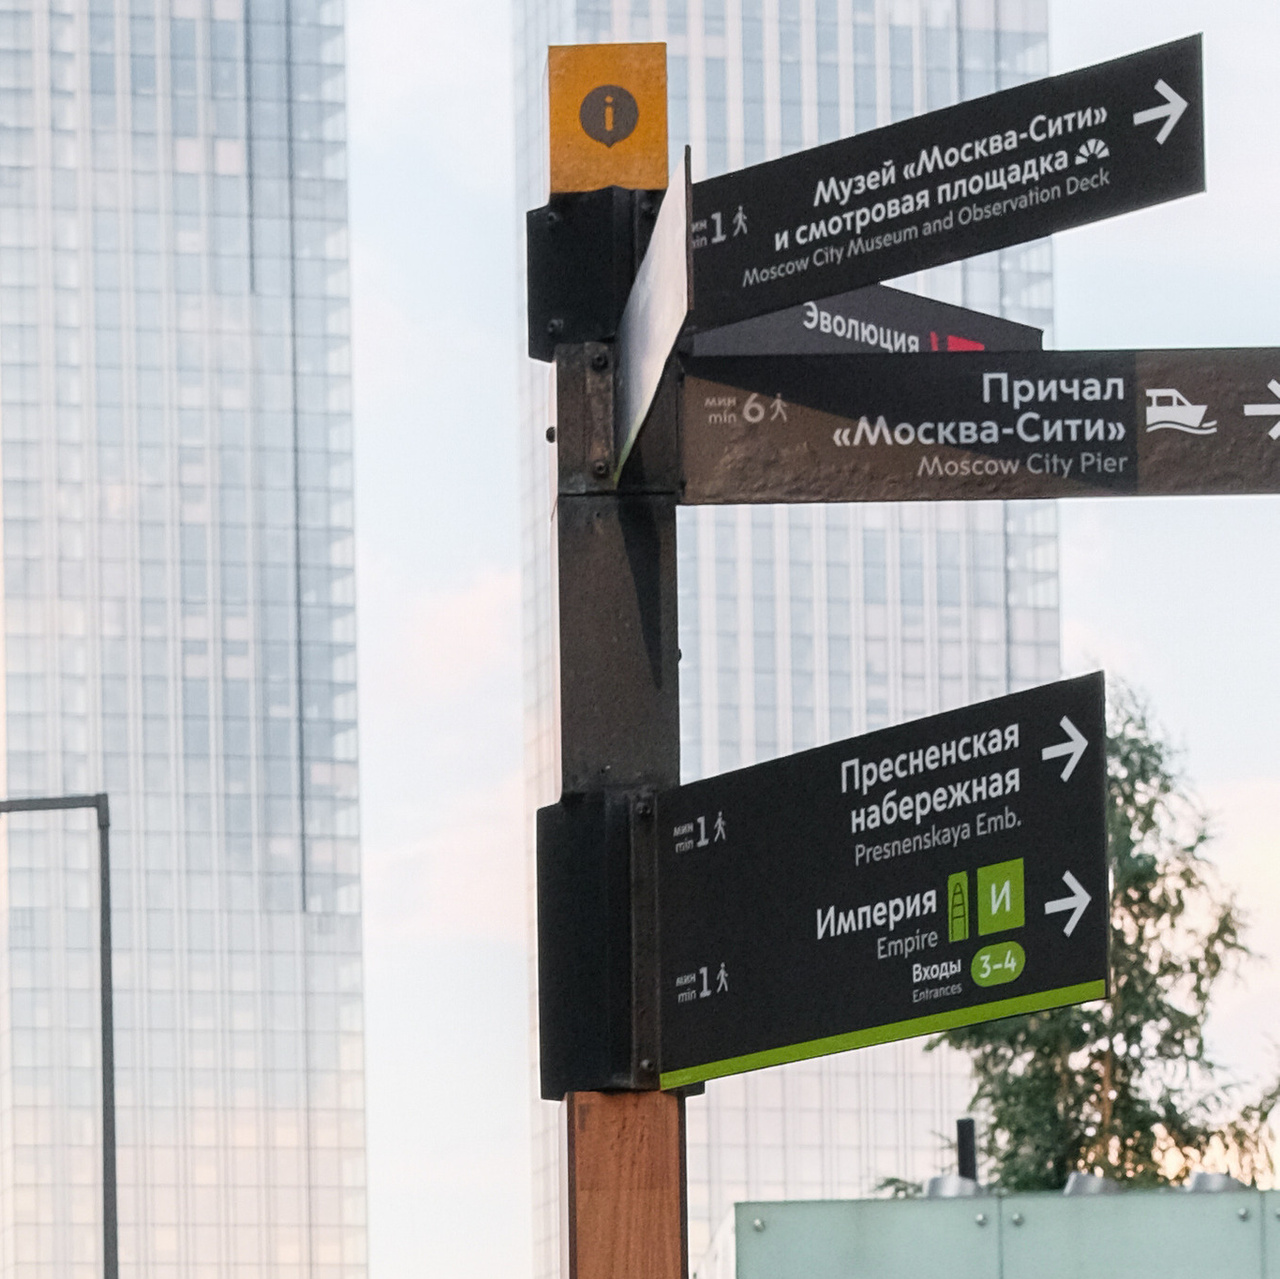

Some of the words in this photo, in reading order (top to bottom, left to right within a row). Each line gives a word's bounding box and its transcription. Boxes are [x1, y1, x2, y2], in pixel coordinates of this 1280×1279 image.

[813, 159, 896, 207] Музей
[903, 106, 1108, 180] «Москва-Сити»
[774, 230, 789, 251] и
[795, 189, 930, 245] смотровая
[936, 150, 1069, 204] площадка
[691, 219, 708, 233] ин
[711, 211, 726, 244] 1
[742, 256, 810, 287] Moscow
[812, 245, 844, 265] City
[847, 225, 918, 258] Museum
[922, 210, 953, 236] and
[957, 184, 1061, 226] Observation
[1066, 167, 1110, 196] Deck
[803, 301, 920, 353] Эволюция
[982, 372, 1125, 410] Причал
[704, 396, 737, 407] мин
[742, 392, 765, 424] 6
[708, 408, 737, 424] min
[832, 412, 1126, 447] «Москва-Сити»
[917, 455, 1020, 477] Moscow
[1026, 452, 1073, 479] City
[1080, 451, 1129, 474] Pier
[841, 723, 1020, 796] Пресненская
[851, 767, 1020, 834] набережная
[675, 837, 694, 853] min
[696, 815, 710, 848] 1
[854, 822, 971, 867] Presnenskaya
[976, 805, 1022, 837] Emb.
[816, 889, 937, 941] Империя
[990, 879, 1011, 916] И
[877, 928, 939, 960] Empire
[699, 966, 712, 999] 1
[912, 958, 962, 984] Входы
[677, 987, 697, 1004] min
[912, 982, 963, 1003] Entrances
